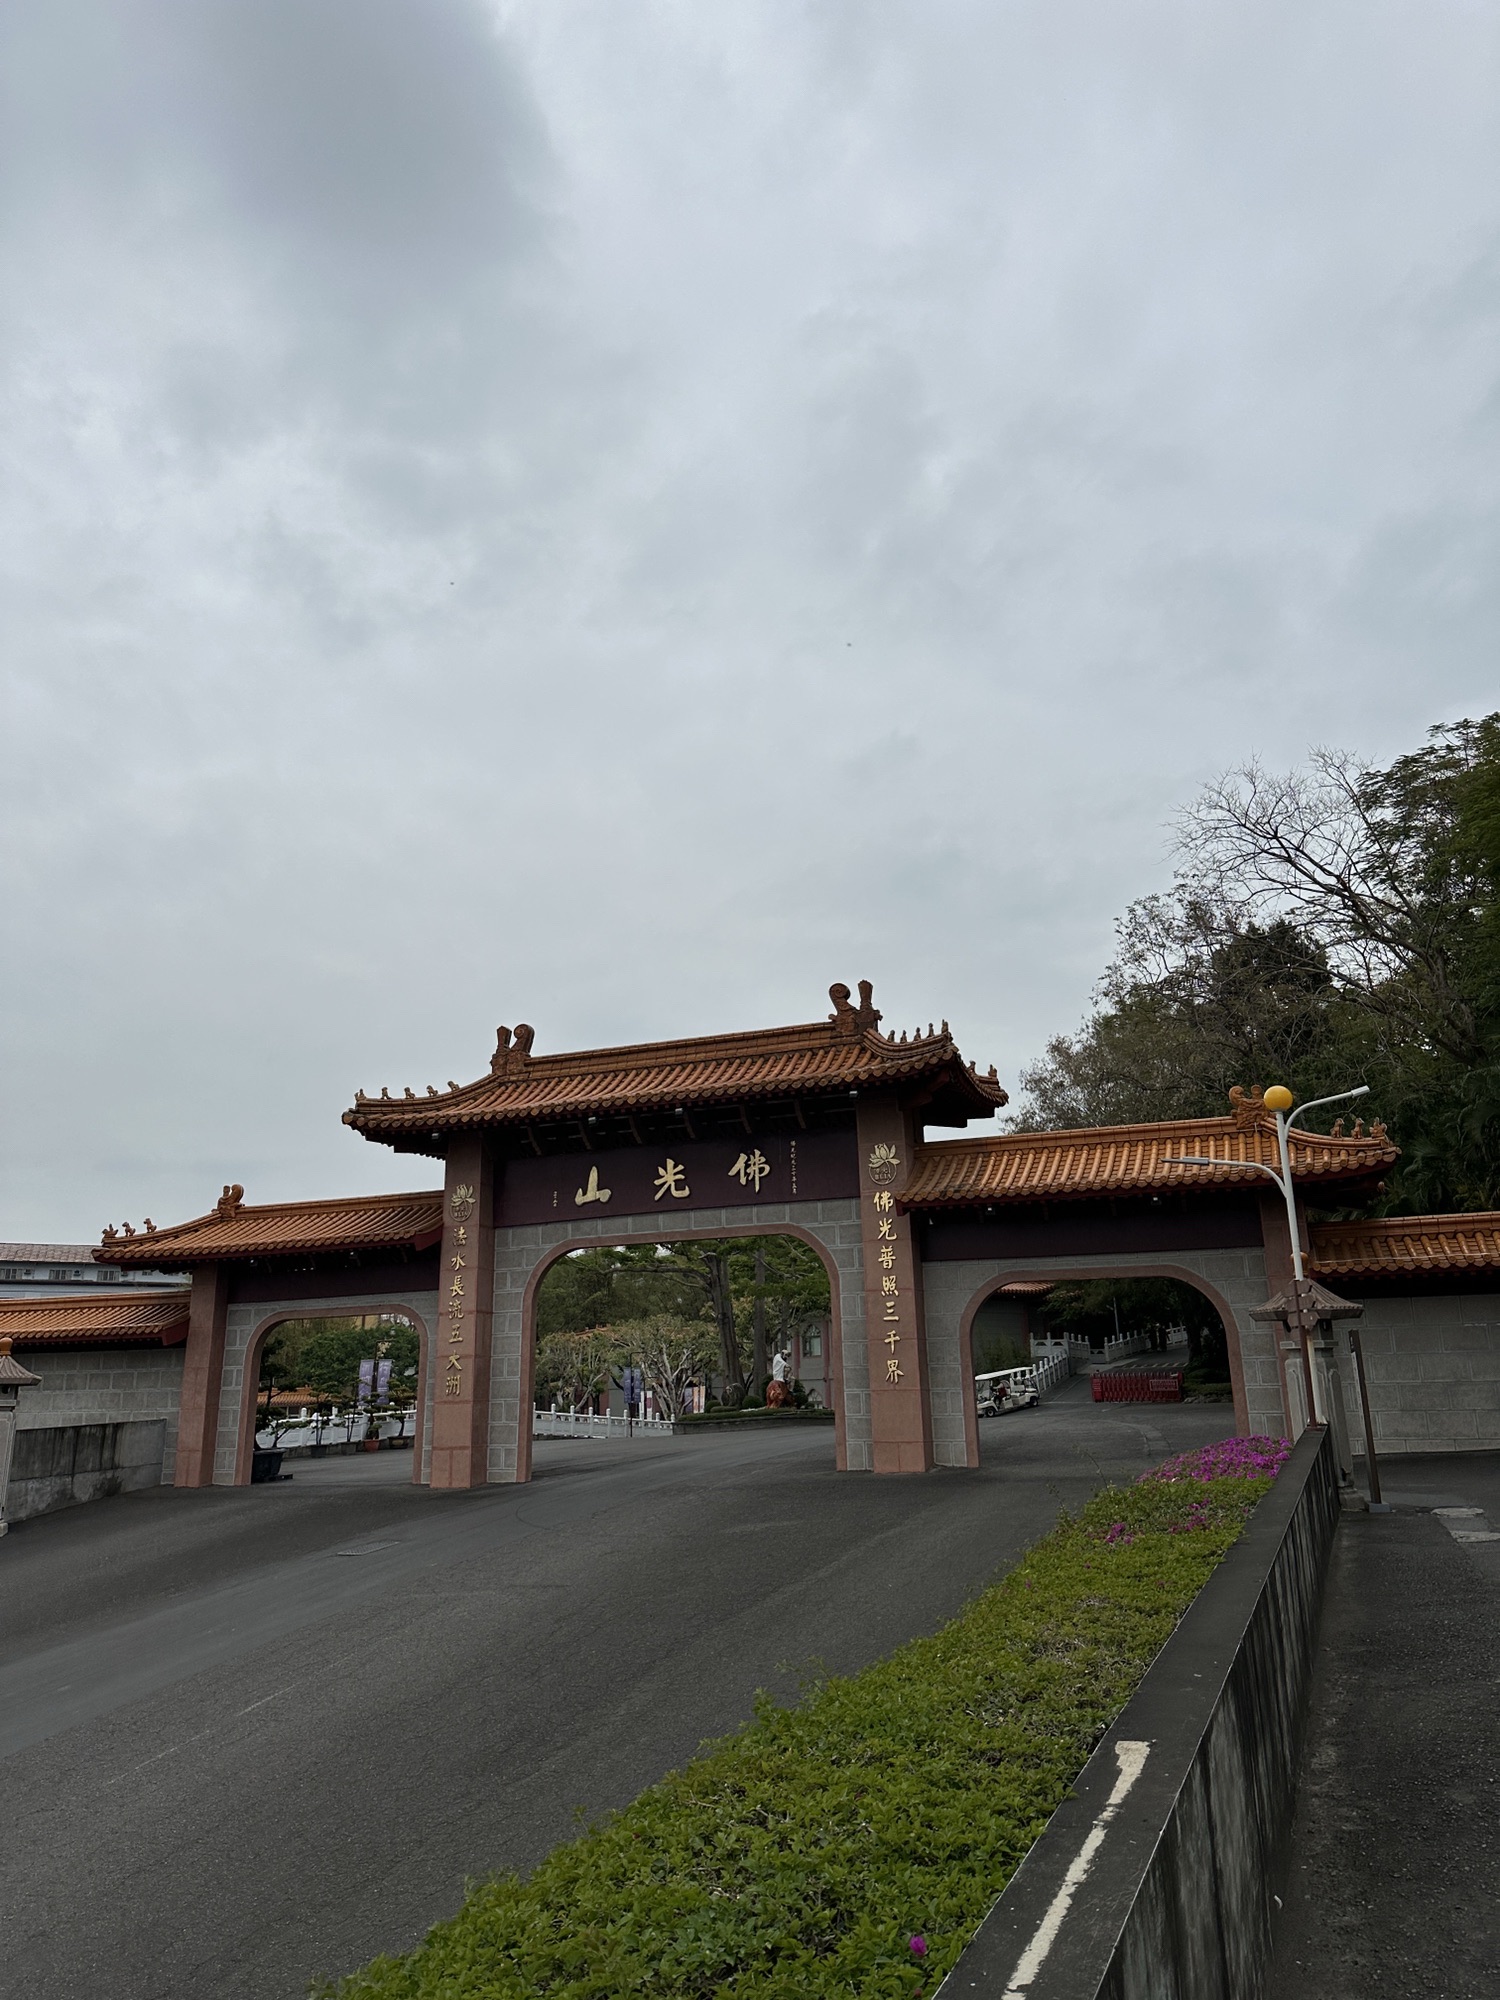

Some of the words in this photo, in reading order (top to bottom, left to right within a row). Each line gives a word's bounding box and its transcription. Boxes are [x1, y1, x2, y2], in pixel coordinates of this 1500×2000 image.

[575, 1148, 771, 1207] 佛光山
[445, 1226, 468, 1396] 法水長流五大洲
[873, 1190, 905, 1384] 佛光普照三千界
